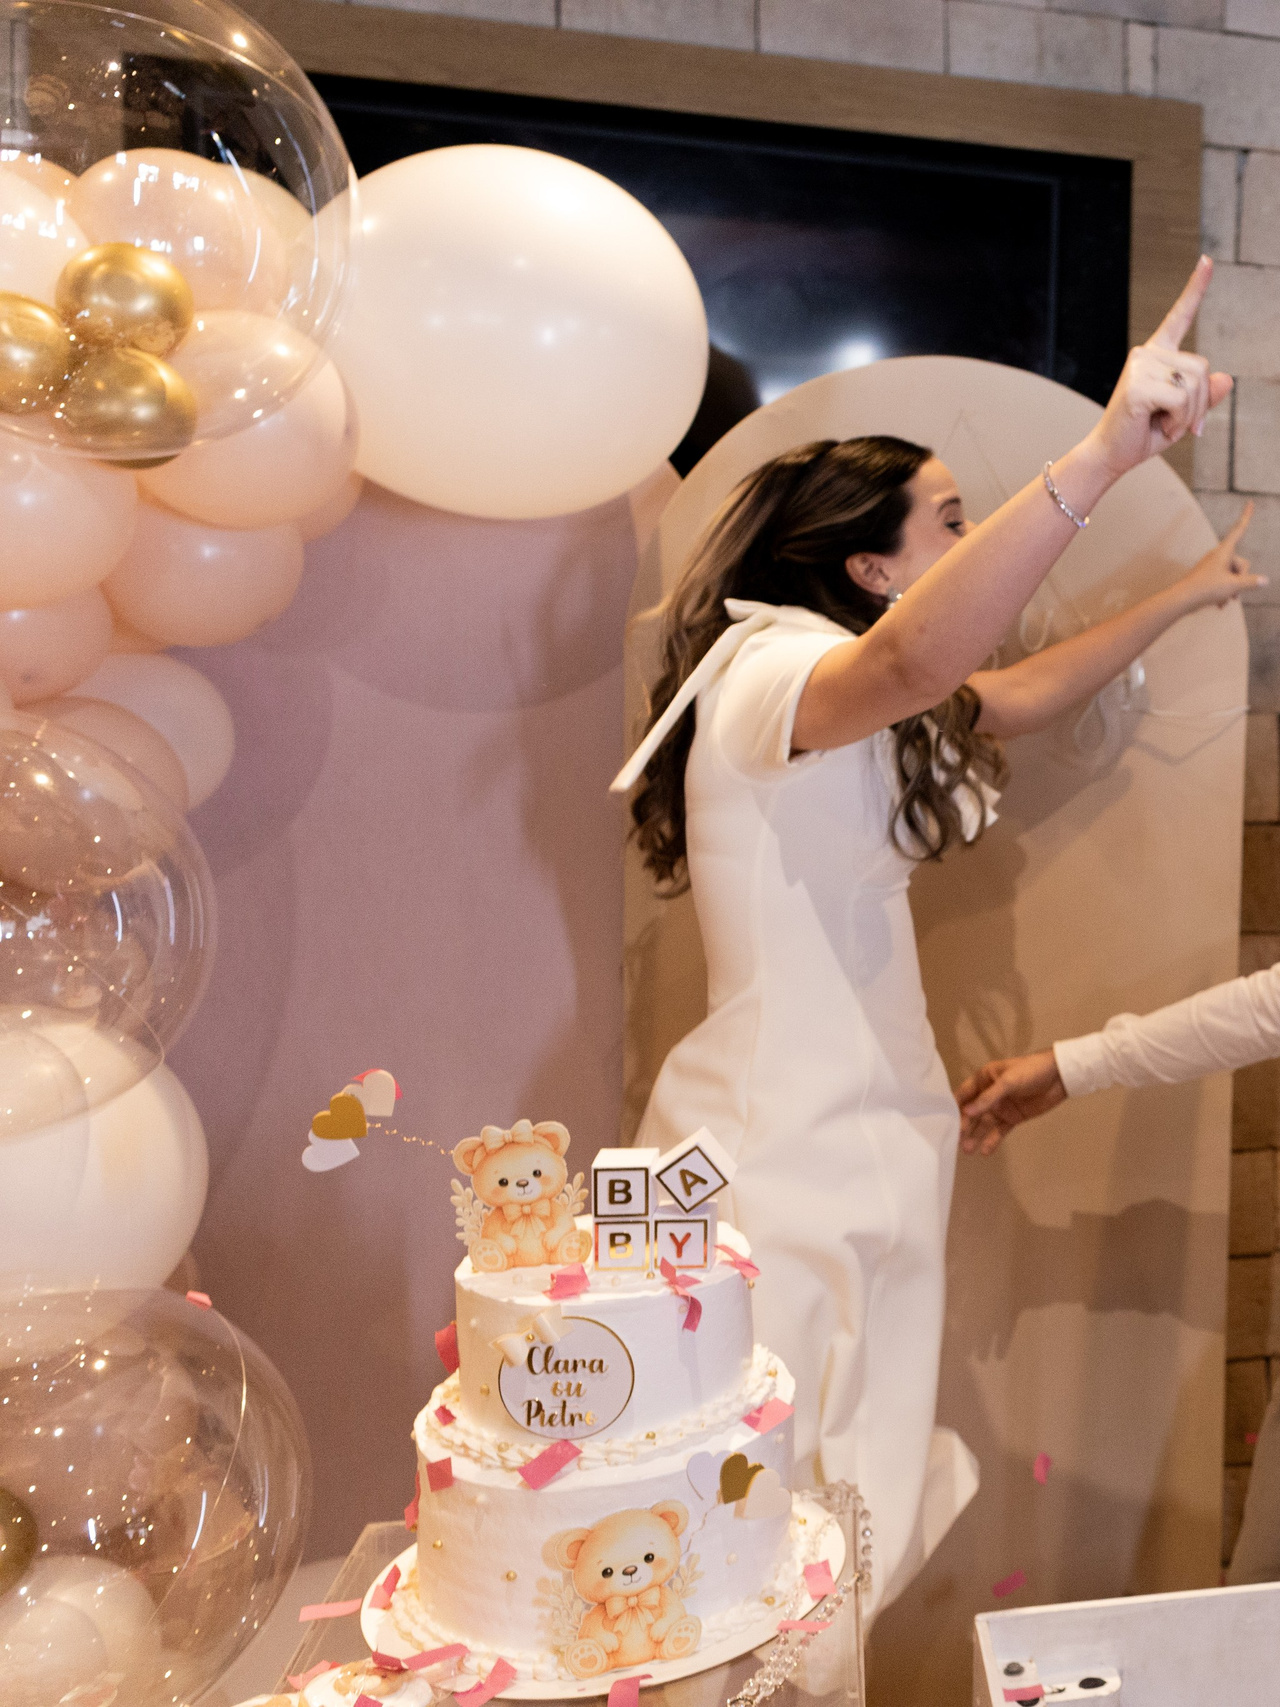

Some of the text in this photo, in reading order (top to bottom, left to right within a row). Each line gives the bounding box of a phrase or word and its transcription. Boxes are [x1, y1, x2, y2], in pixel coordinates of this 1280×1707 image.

[526, 1345, 608, 1375] Clara
[551, 1380, 587, 1397] ou
[522, 1399, 597, 1427] Pietro
